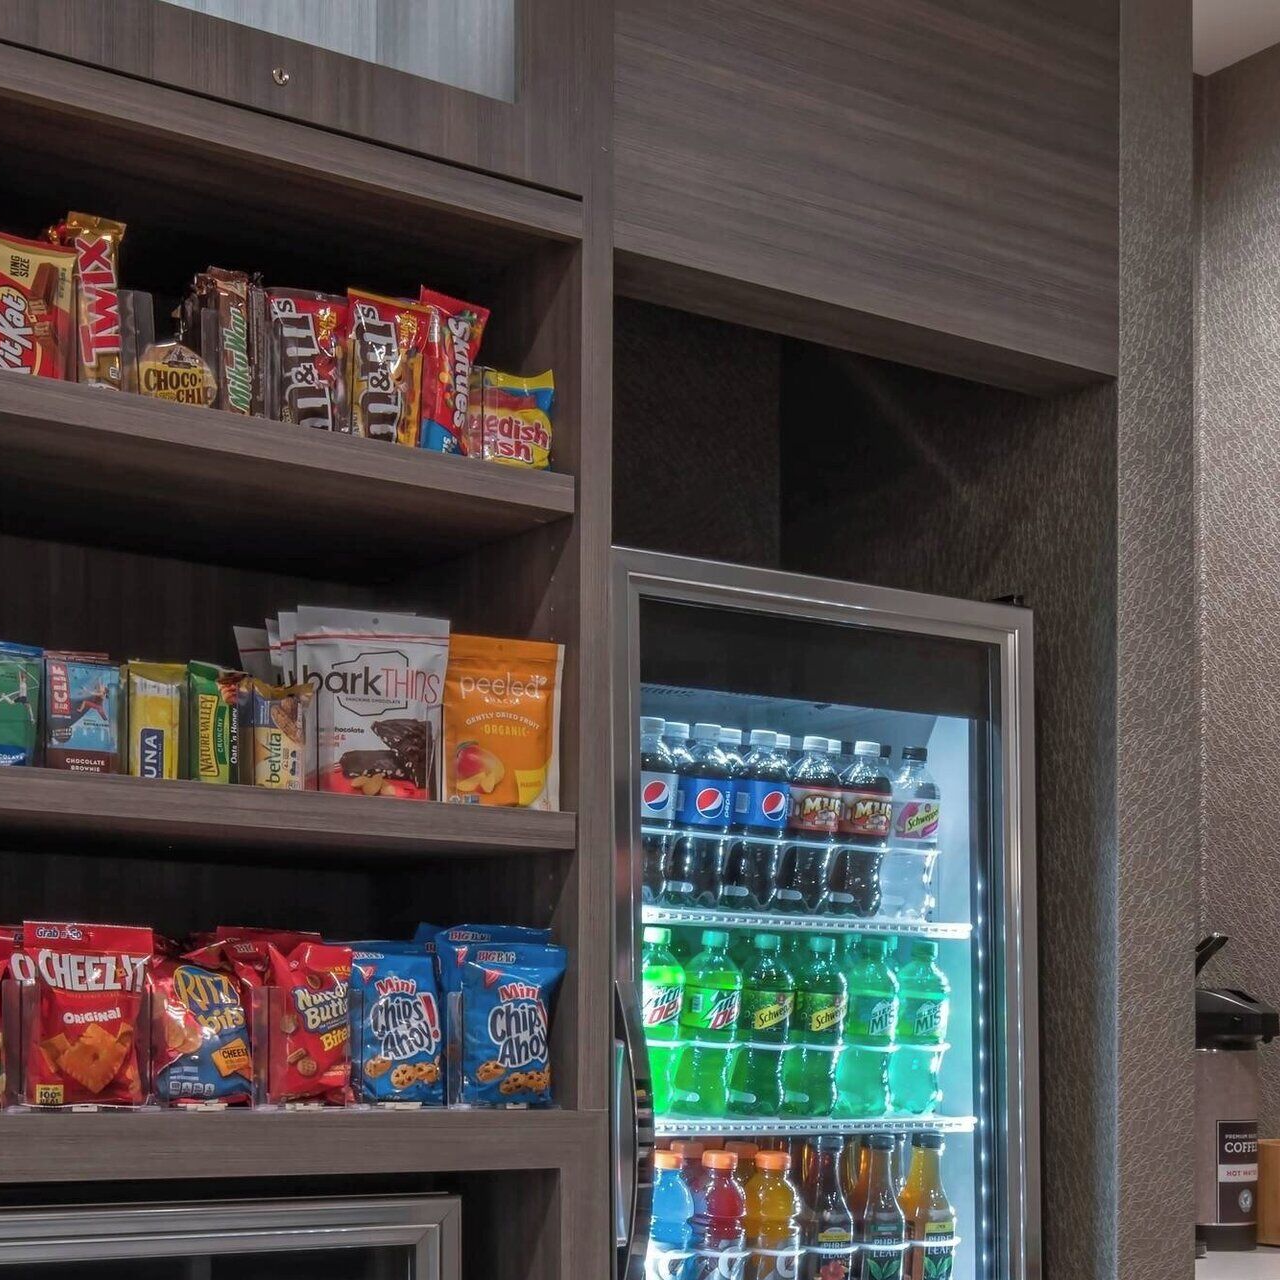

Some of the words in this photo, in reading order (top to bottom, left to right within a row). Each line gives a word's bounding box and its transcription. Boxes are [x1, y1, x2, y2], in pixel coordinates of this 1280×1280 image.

[10, 255, 19, 277] KING
[20, 257, 31, 278] SIZE
[75, 237, 120, 367] TWIX
[449, 318, 471, 428] Skittles
[51, 663, 69, 702] CLIF
[460, 673, 540, 699] peeled
[465, 712, 491, 726] GENTLY
[483, 723, 528, 737] ORGANIC
[65, 757, 105, 766] CHOCOLATE
[230, 742, 239, 764] Oats
[266, 732, 282, 785] belVita
[803, 797, 840, 817] MUG
[855, 801, 891, 822] MUG
[35, 927, 59, 939] Grab
[69, 929, 82, 940] Go
[173, 967, 240, 1011] RITZ
[374, 977, 417, 997] Mini
[497, 983, 538, 1001] Mini
[198, 1010, 244, 1034] bits
[371, 994, 424, 1037] Chips
[489, 1002, 542, 1042] Chips
